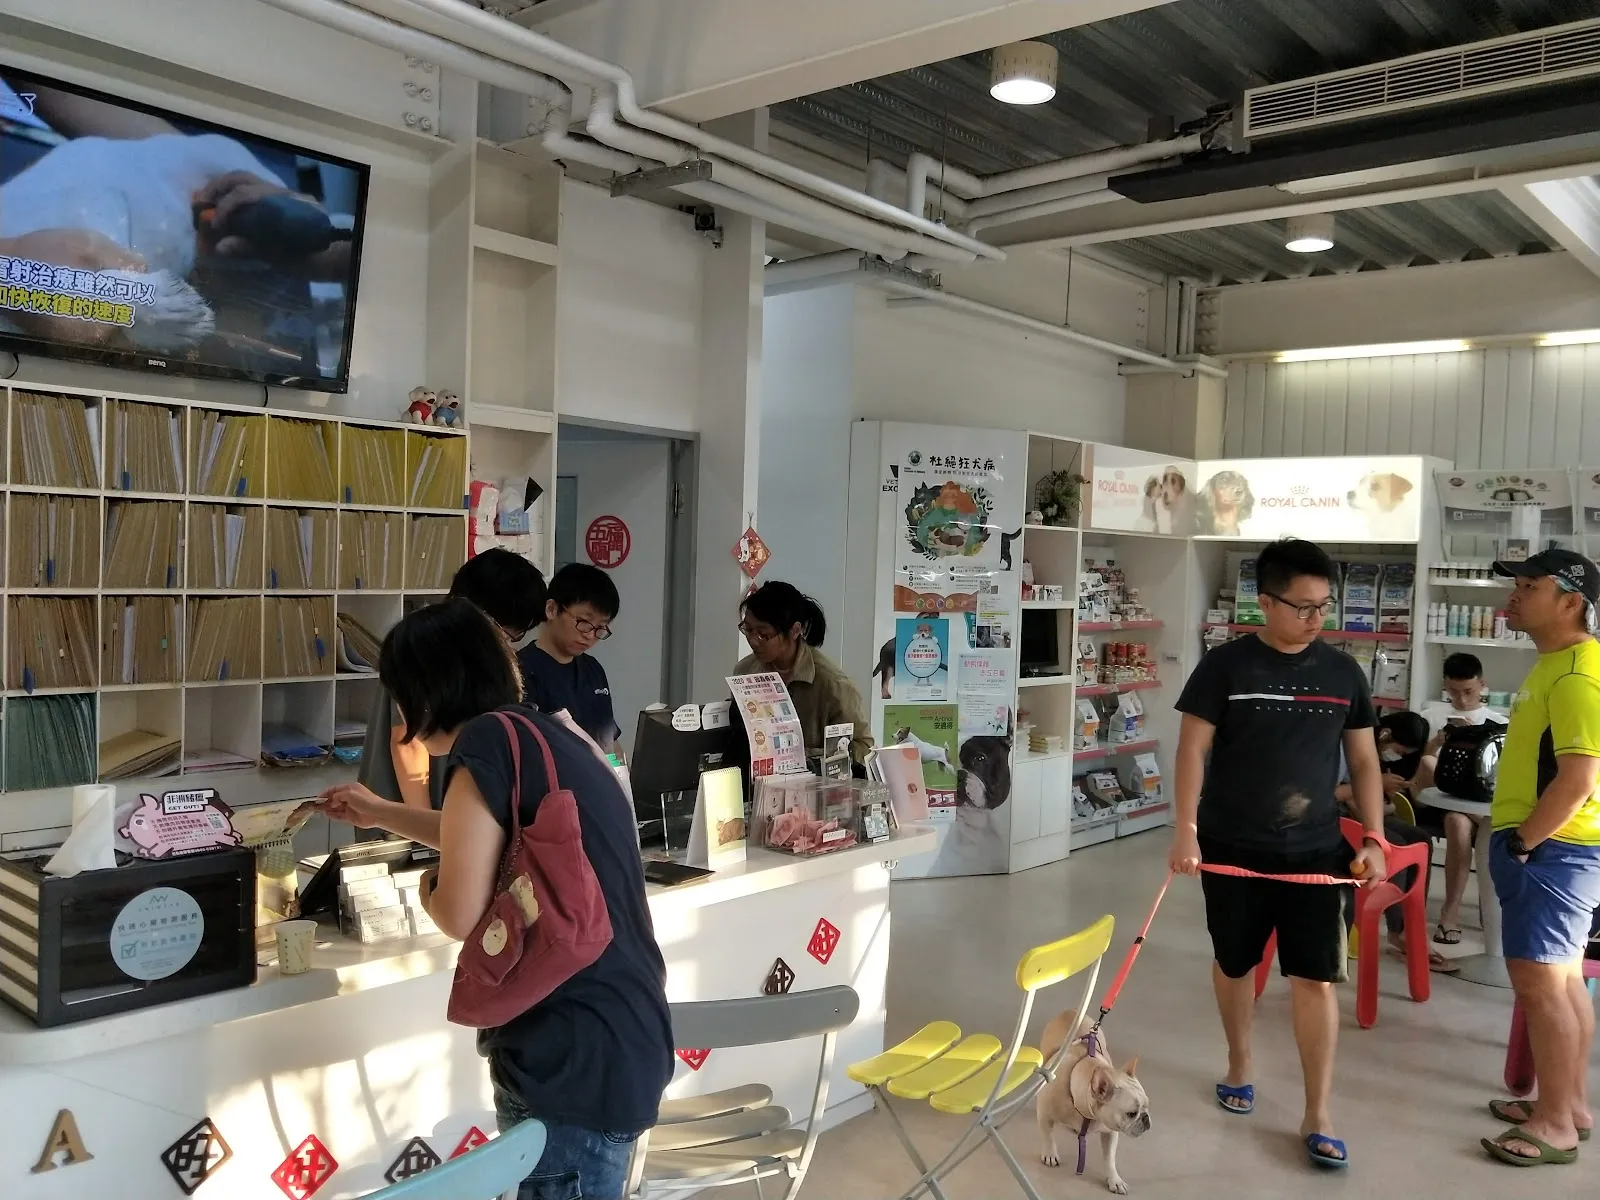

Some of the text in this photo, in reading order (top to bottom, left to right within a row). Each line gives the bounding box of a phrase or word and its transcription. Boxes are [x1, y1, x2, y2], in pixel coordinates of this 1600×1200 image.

[929, 455, 996, 472] 杜絕狂犬病
[1260, 496, 1340, 508] ROYAL CANIN
[31, 1108, 94, 1174] A
